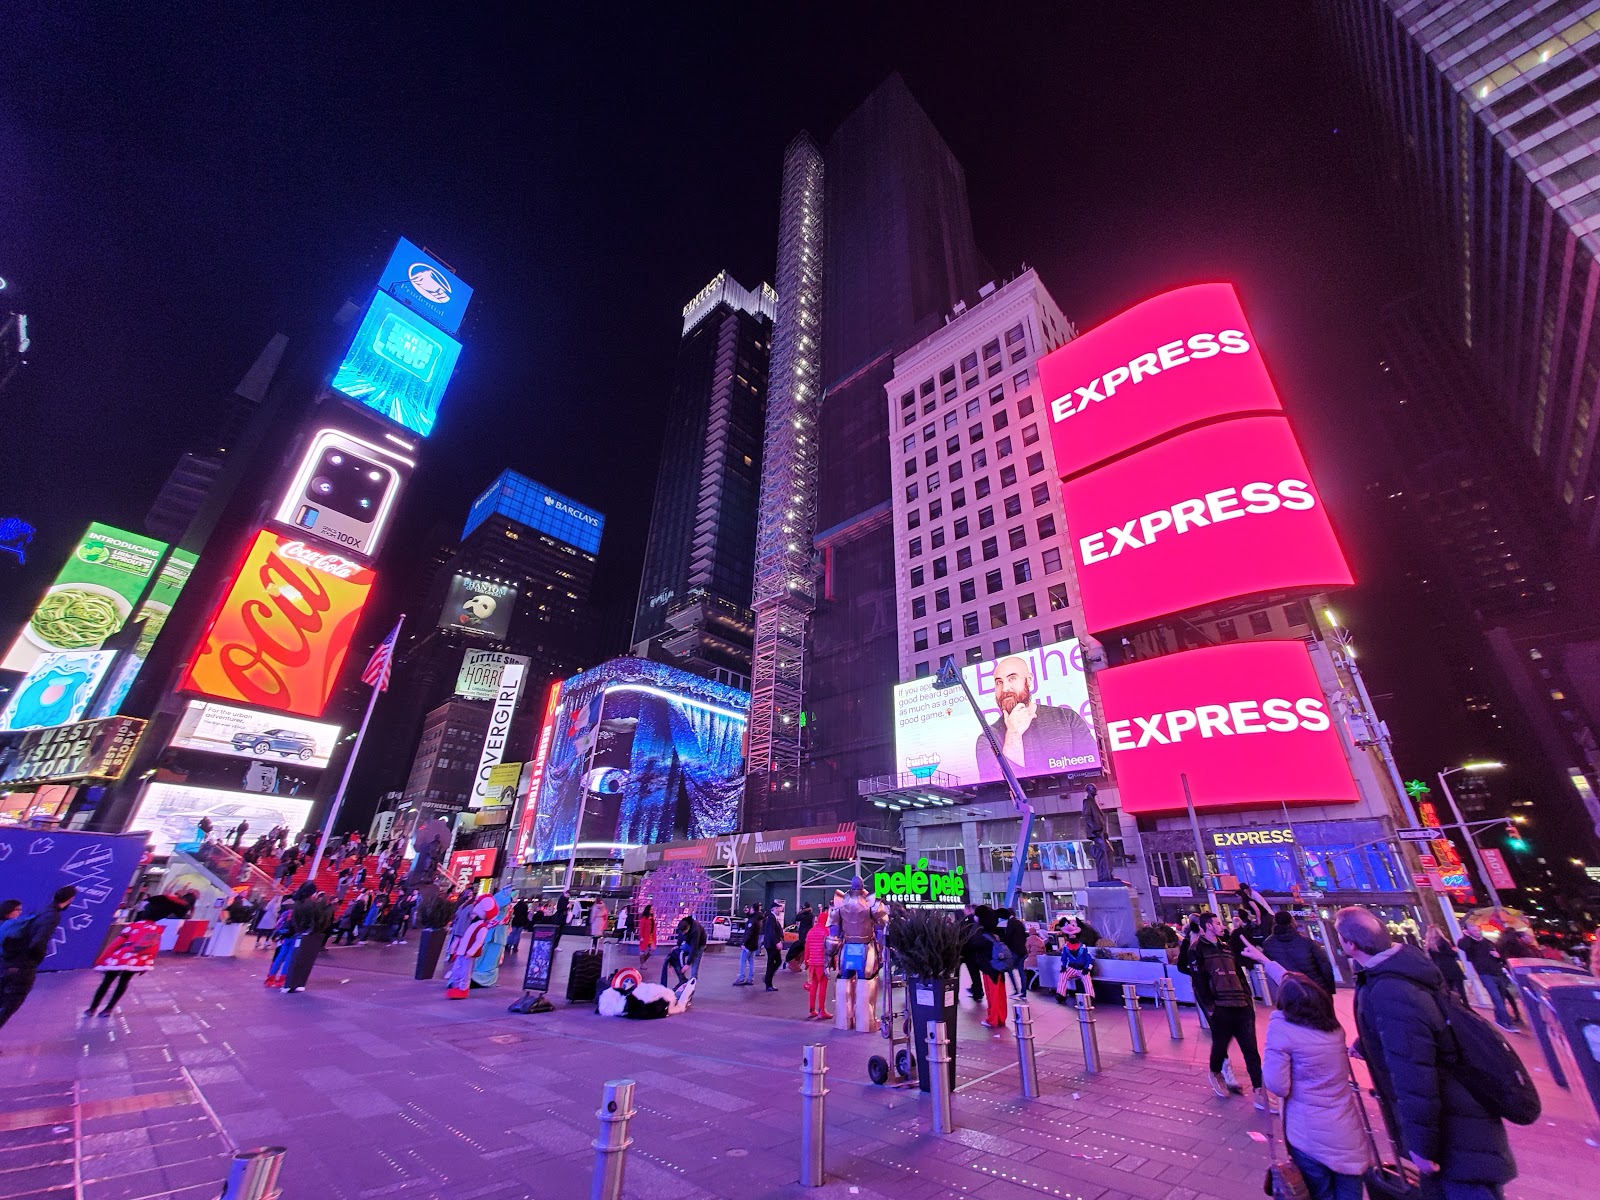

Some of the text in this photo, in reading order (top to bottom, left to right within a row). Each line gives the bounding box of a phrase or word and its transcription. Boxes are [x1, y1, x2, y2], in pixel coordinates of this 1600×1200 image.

[401, 283, 444, 317] Prudential
[1050, 330, 1250, 423] EXPRESS
[555, 501, 599, 527] BARCLAYS
[1079, 479, 1315, 566] EXPRESS
[88, 532, 160, 557] INTRODUCING
[336, 531, 362, 549] 100X
[463, 579, 507, 596] PHANTOM
[470, 653, 502, 664] LITTLE
[898, 689, 903, 697] If
[905, 686, 918, 697] you
[898, 695, 918, 708] good
[920, 690, 942, 701] beard
[232, 710, 253, 719] urban
[909, 702, 931, 714] much
[900, 711, 945, 727] good game.
[1107, 697, 1331, 752] EXPRESS
[39, 722, 98, 744] WEST
[476, 679, 518, 797] COVERGIRL
[31, 740, 88, 761] SIDE
[100, 719, 133, 774] WEST SIDE
[114, 731, 136, 766] STORY
[16, 756, 85, 778] STORY
[526, 725, 552, 811] HERSHEY'S STORE
[905, 751, 941, 768] twitch
[1048, 753, 1095, 769] Bajheera
[754, 839, 785, 854] BROADWAY
[1213, 829, 1294, 847] EXPRESS
[714, 833, 740, 867] TSX
[886, 893, 922, 902] SOCCER
[938, 895, 961, 903] SOCCER
